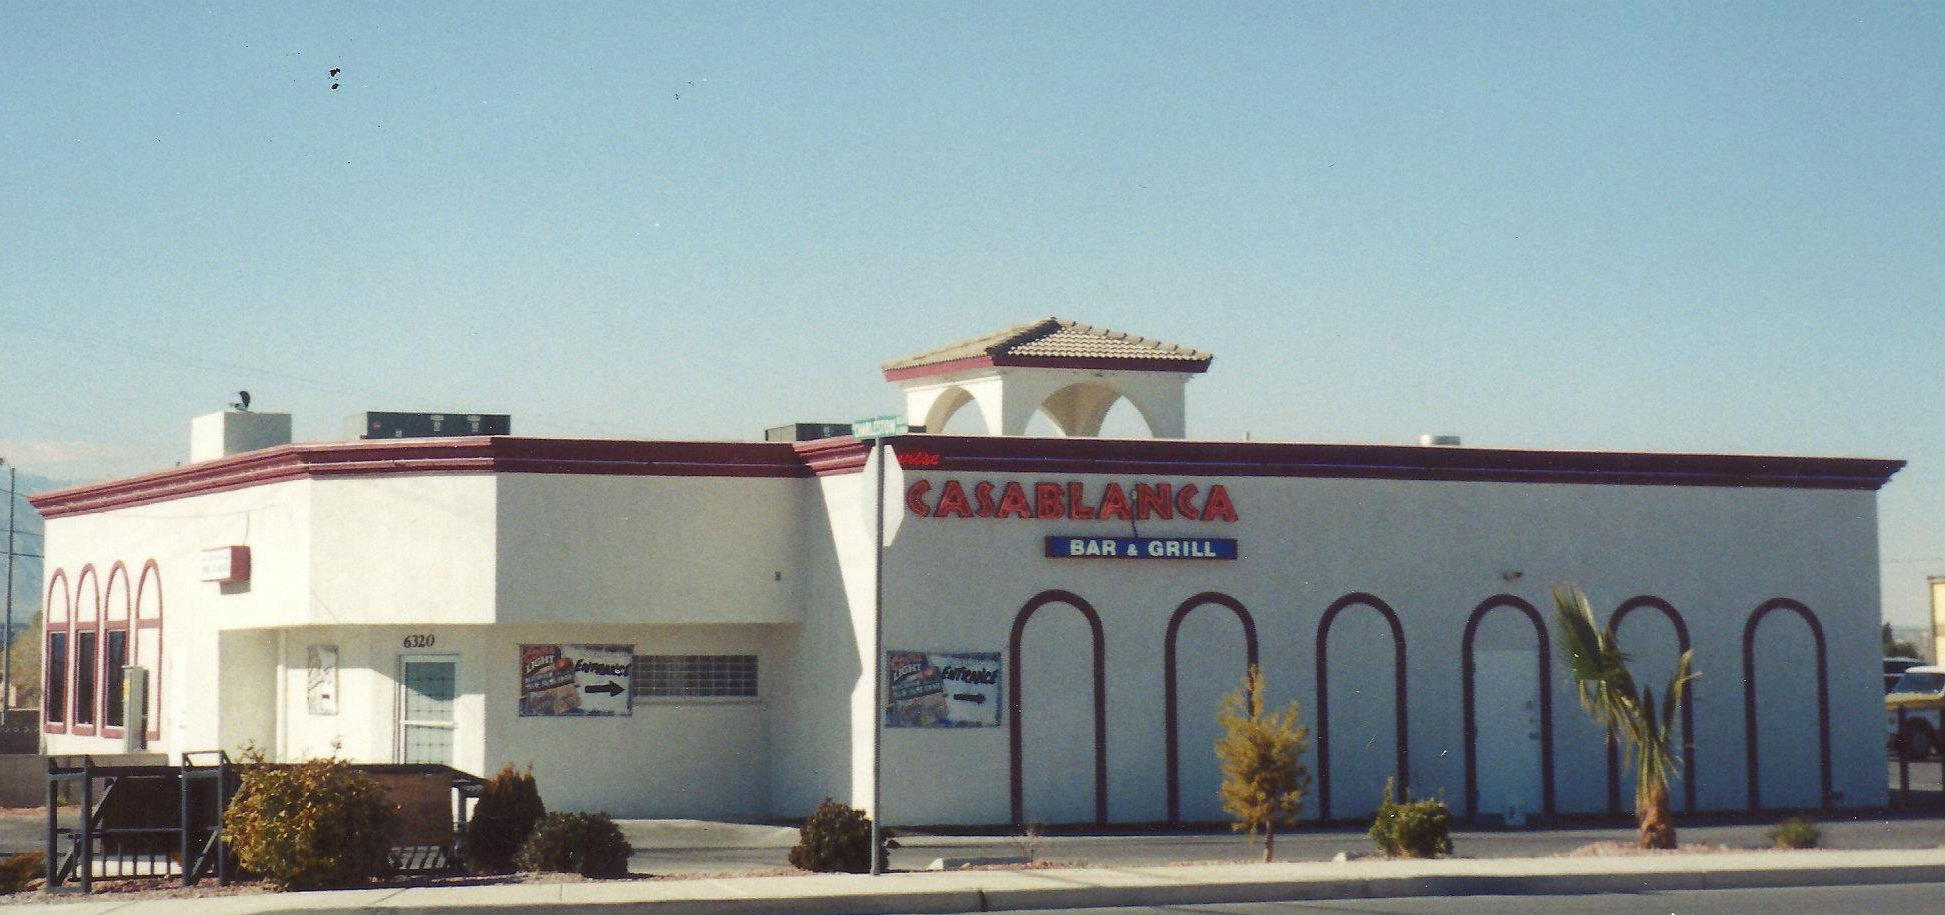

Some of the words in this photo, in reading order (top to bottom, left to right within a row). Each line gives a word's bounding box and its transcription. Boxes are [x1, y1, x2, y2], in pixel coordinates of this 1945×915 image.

[905, 479, 1239, 523] CASABLANCA
[1069, 538, 1117, 557] BAR
[1127, 543, 1138, 557] &
[1147, 539, 1217, 559] GRILL
[403, 633, 436, 648] 6320
